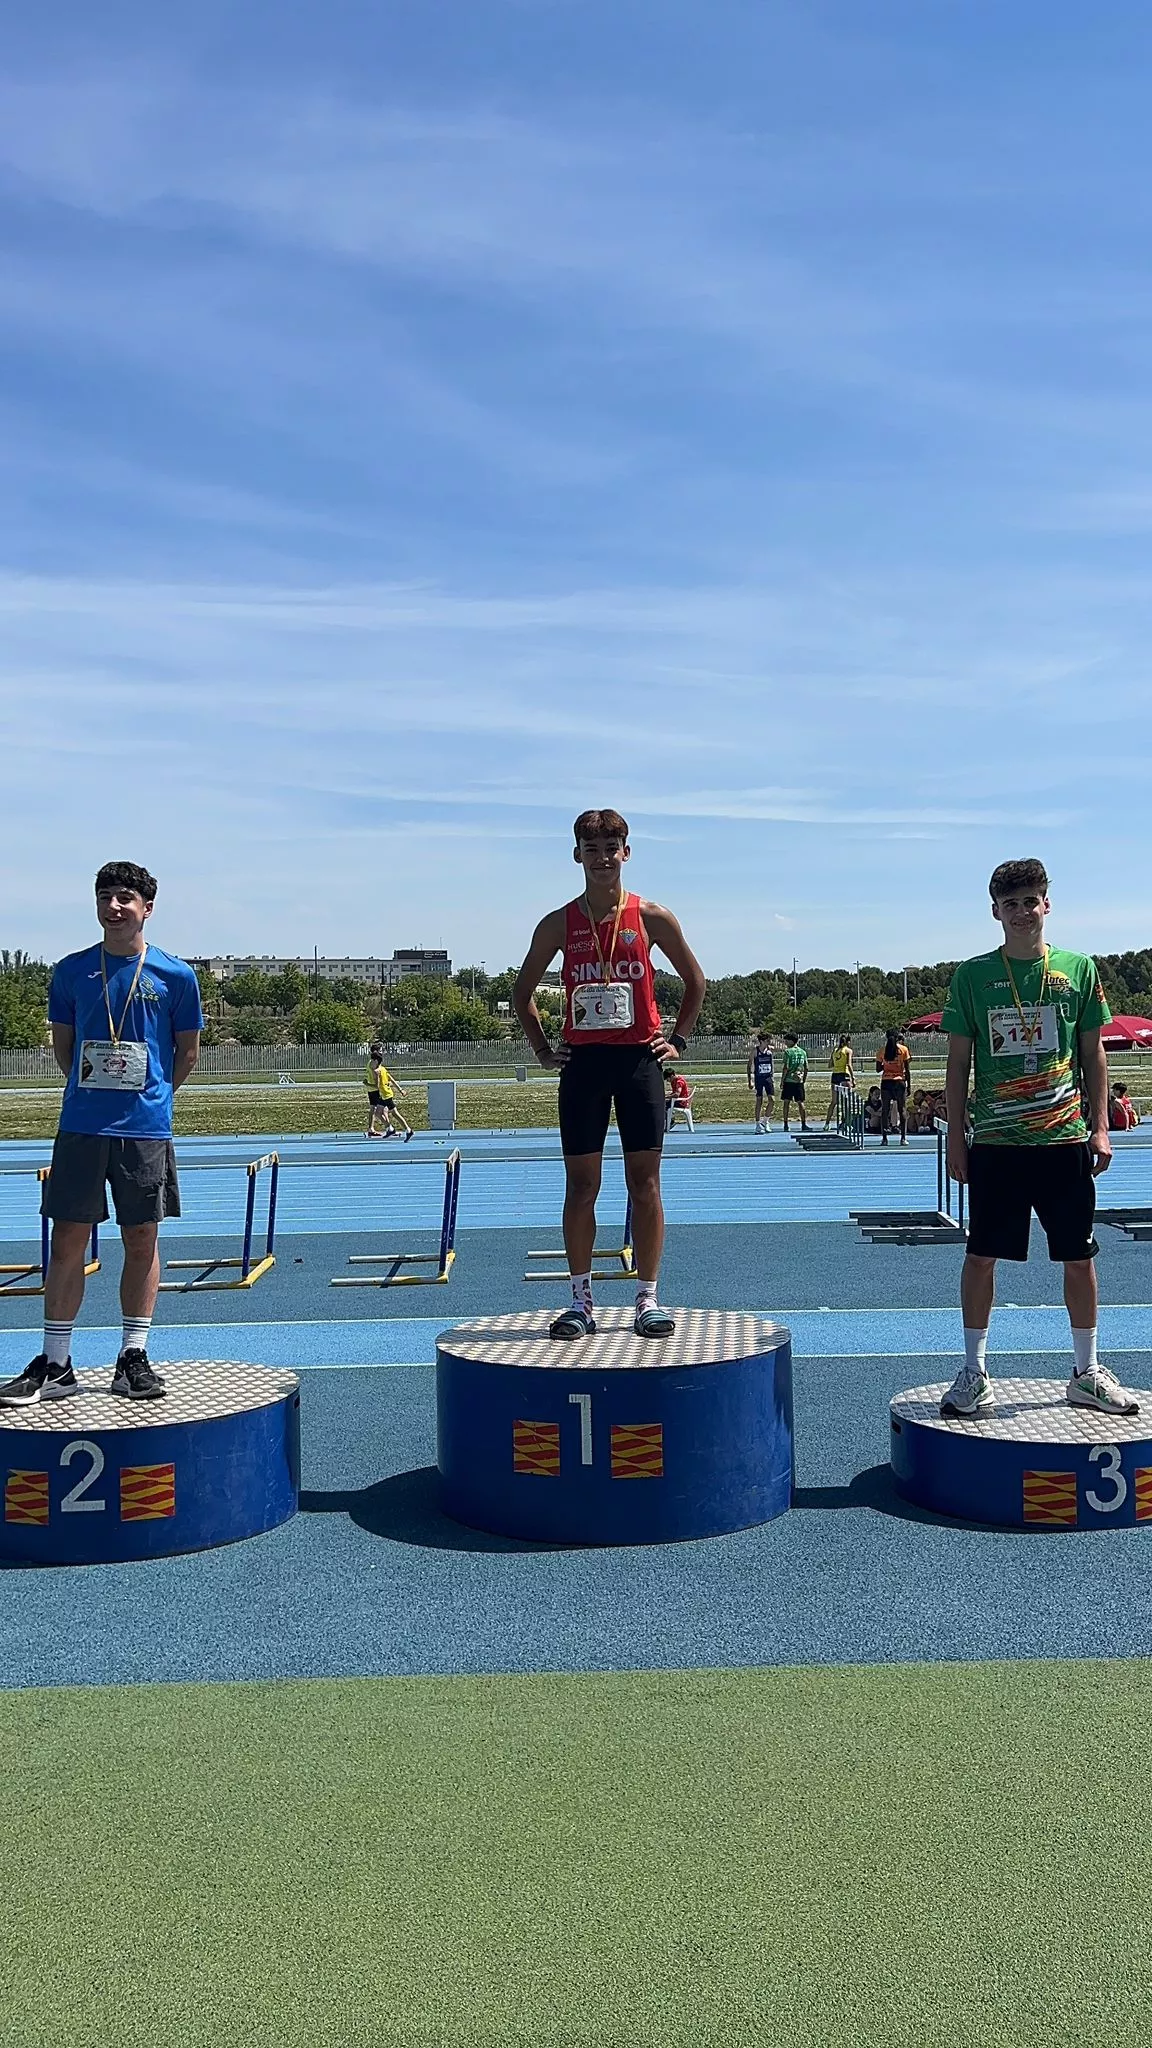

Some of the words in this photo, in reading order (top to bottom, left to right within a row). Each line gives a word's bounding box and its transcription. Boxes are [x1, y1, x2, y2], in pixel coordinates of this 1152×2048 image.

[1007, 1026, 1043, 1042] 121
[568, 1393, 593, 1465] 1
[59, 1439, 106, 1513] 2
[1085, 1444, 1128, 1513] 3
